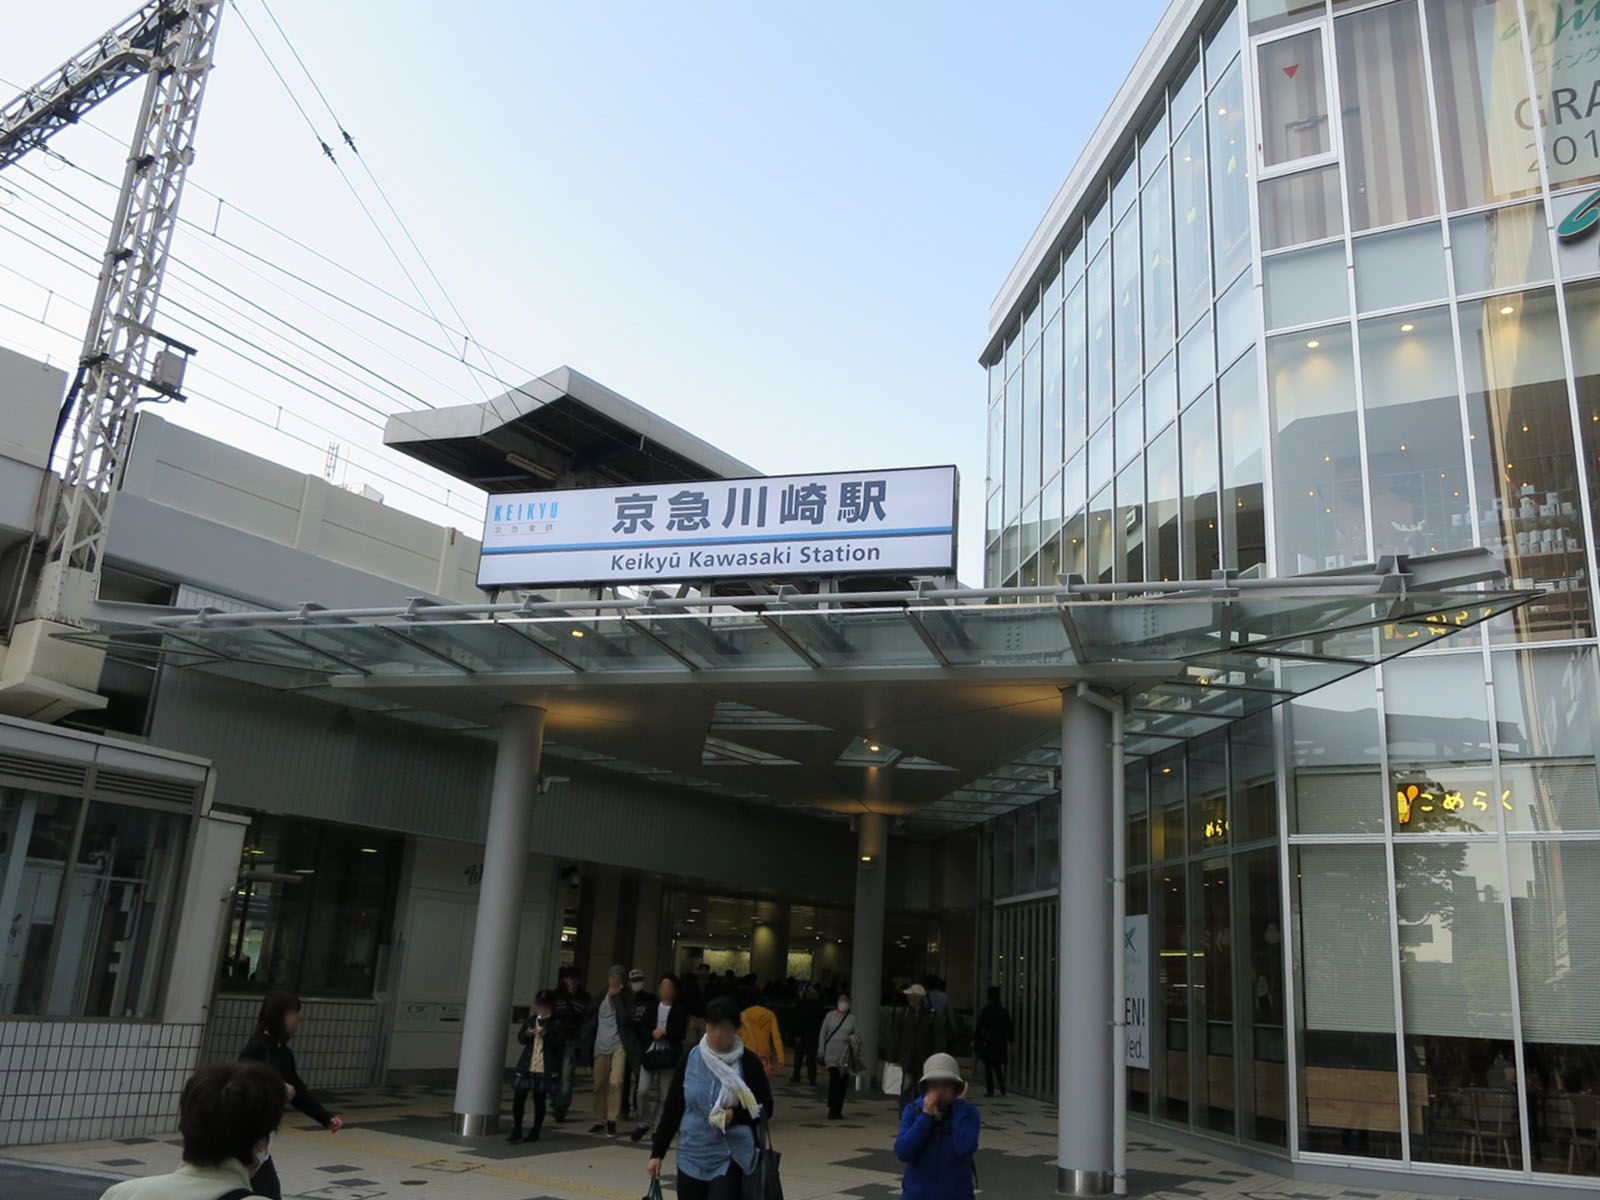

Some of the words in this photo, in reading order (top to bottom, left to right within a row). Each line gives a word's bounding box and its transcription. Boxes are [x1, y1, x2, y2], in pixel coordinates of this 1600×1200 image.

[494, 502, 559, 521] KEIKYU
[612, 480, 887, 534] 京急川崎駅
[611, 552, 680, 573] Keikyū
[689, 547, 791, 568] Kawasaki
[800, 544, 881, 563] Station
[1420, 789, 1513, 812] こめらく
[1125, 1034, 1145, 1059] ed.
